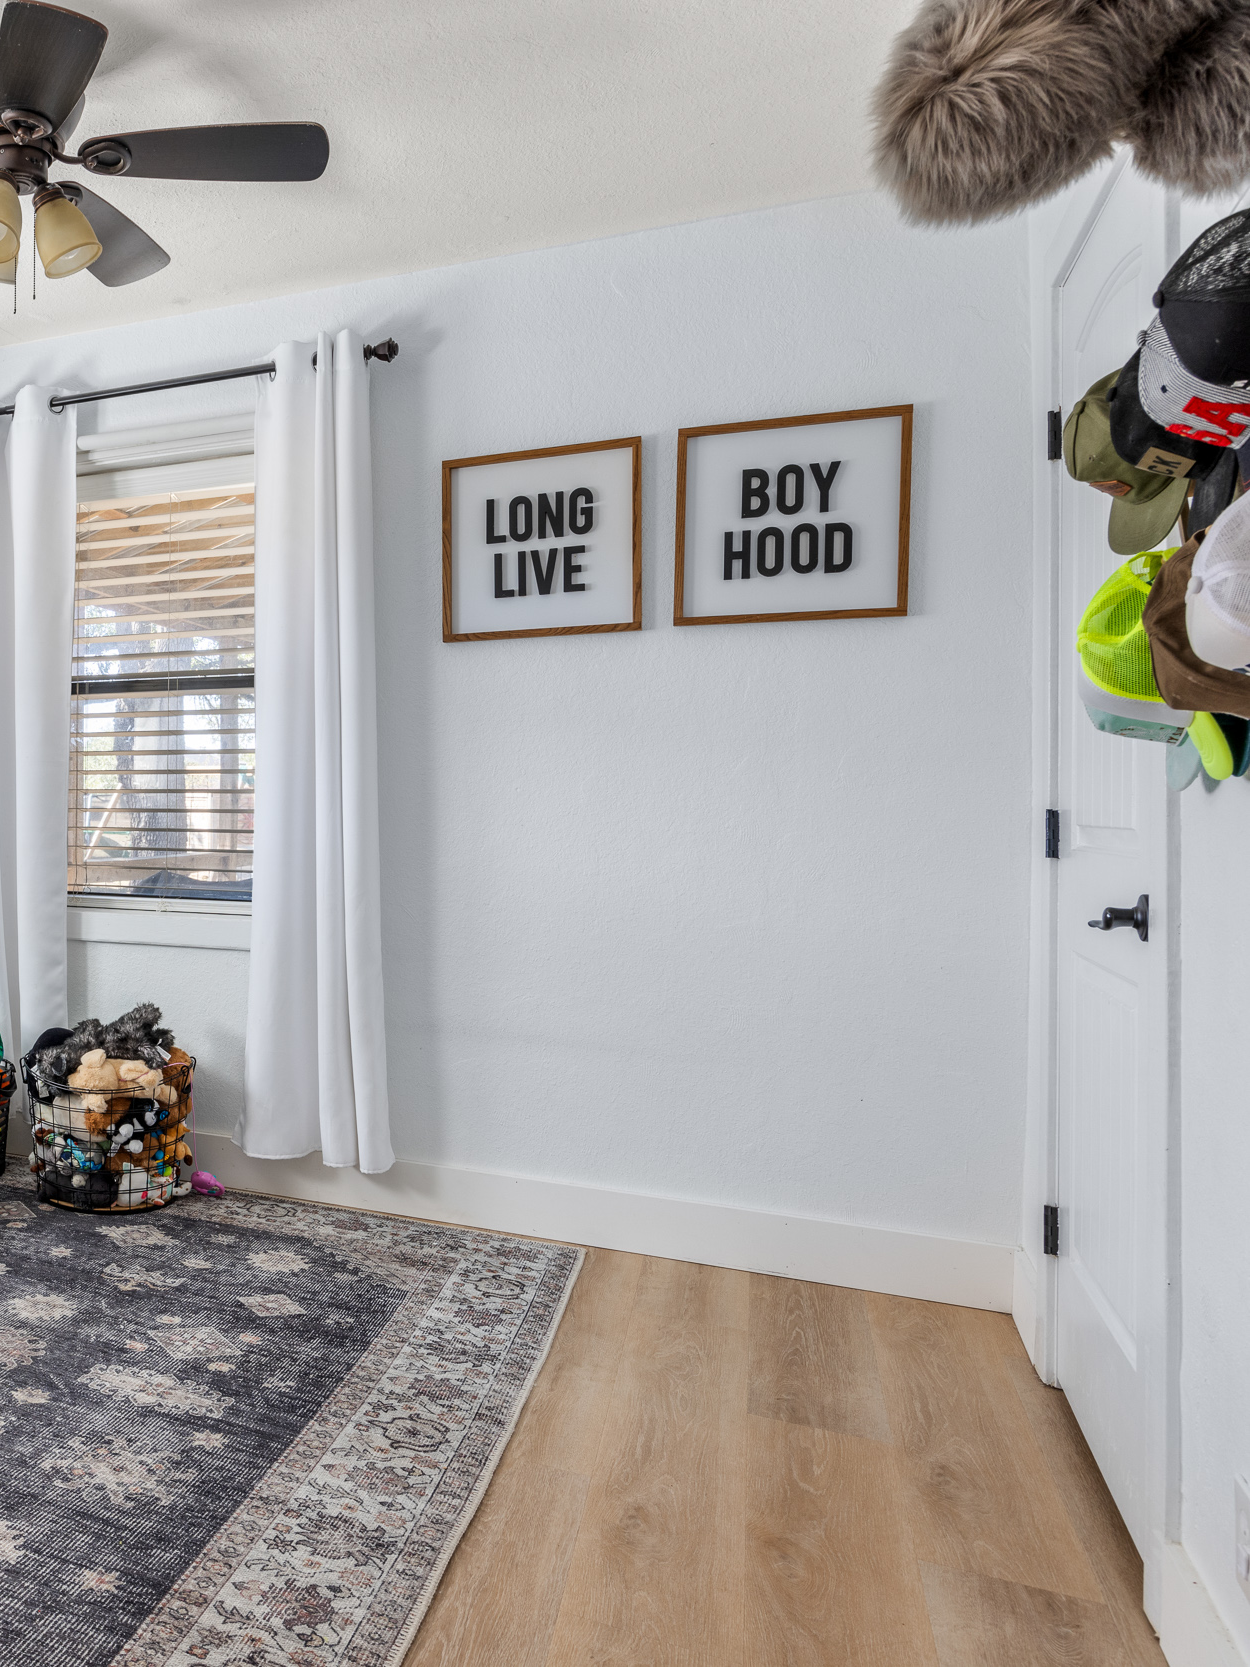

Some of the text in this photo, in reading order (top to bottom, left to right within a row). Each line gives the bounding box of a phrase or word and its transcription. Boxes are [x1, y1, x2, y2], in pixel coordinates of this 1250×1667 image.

[486, 487, 594, 544] LONG
[741, 460, 842, 519] BOY
[494, 545, 586, 599] LIVE
[723, 521, 853, 581] HOOD
